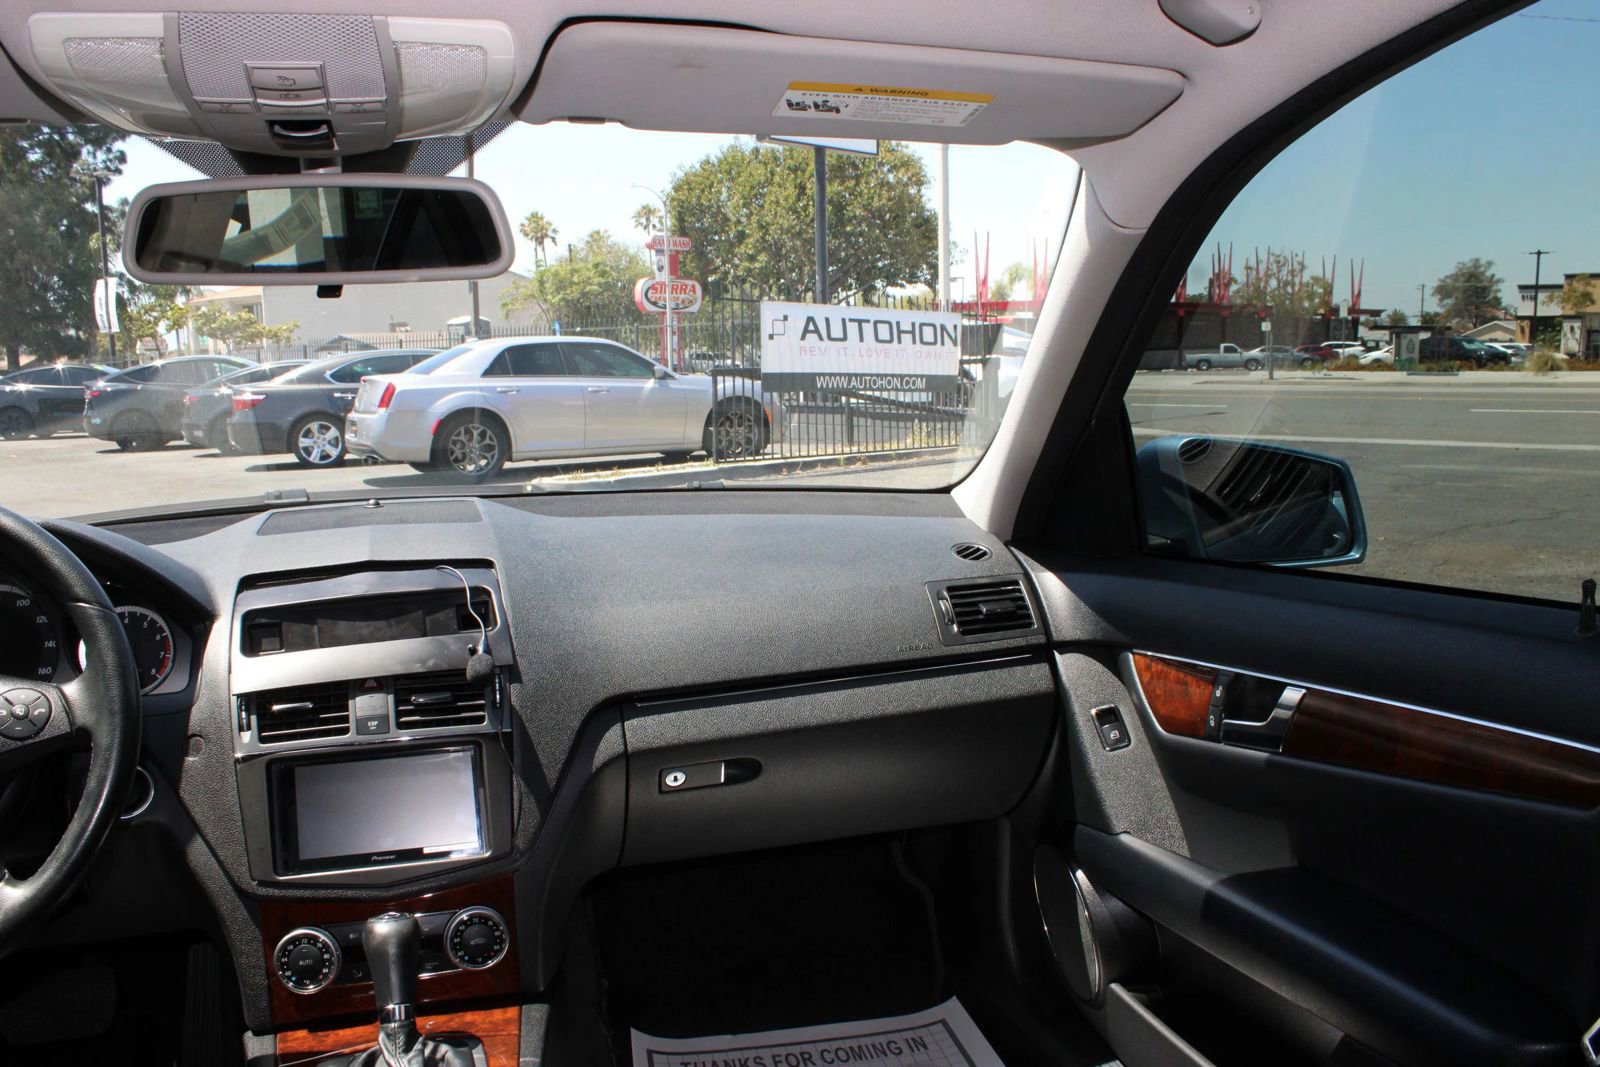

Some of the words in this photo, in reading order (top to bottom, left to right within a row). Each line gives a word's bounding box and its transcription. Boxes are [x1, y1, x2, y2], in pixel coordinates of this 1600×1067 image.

[870, 88, 929, 96] WARNING
[651, 283, 696, 295] SIRRA
[800, 316, 958, 347] AUTOHON
[858, 347, 891, 359] LOVE
[816, 375, 926, 390] WWW.AUTOHON.COM
[16, 599, 31, 607] 100
[159, 651, 165, 659] 7
[38, 666, 52, 675] 160
[772, 1050, 817, 1067] FOR
[820, 1040, 903, 1065] COMING
[905, 1036, 929, 1054] IN
